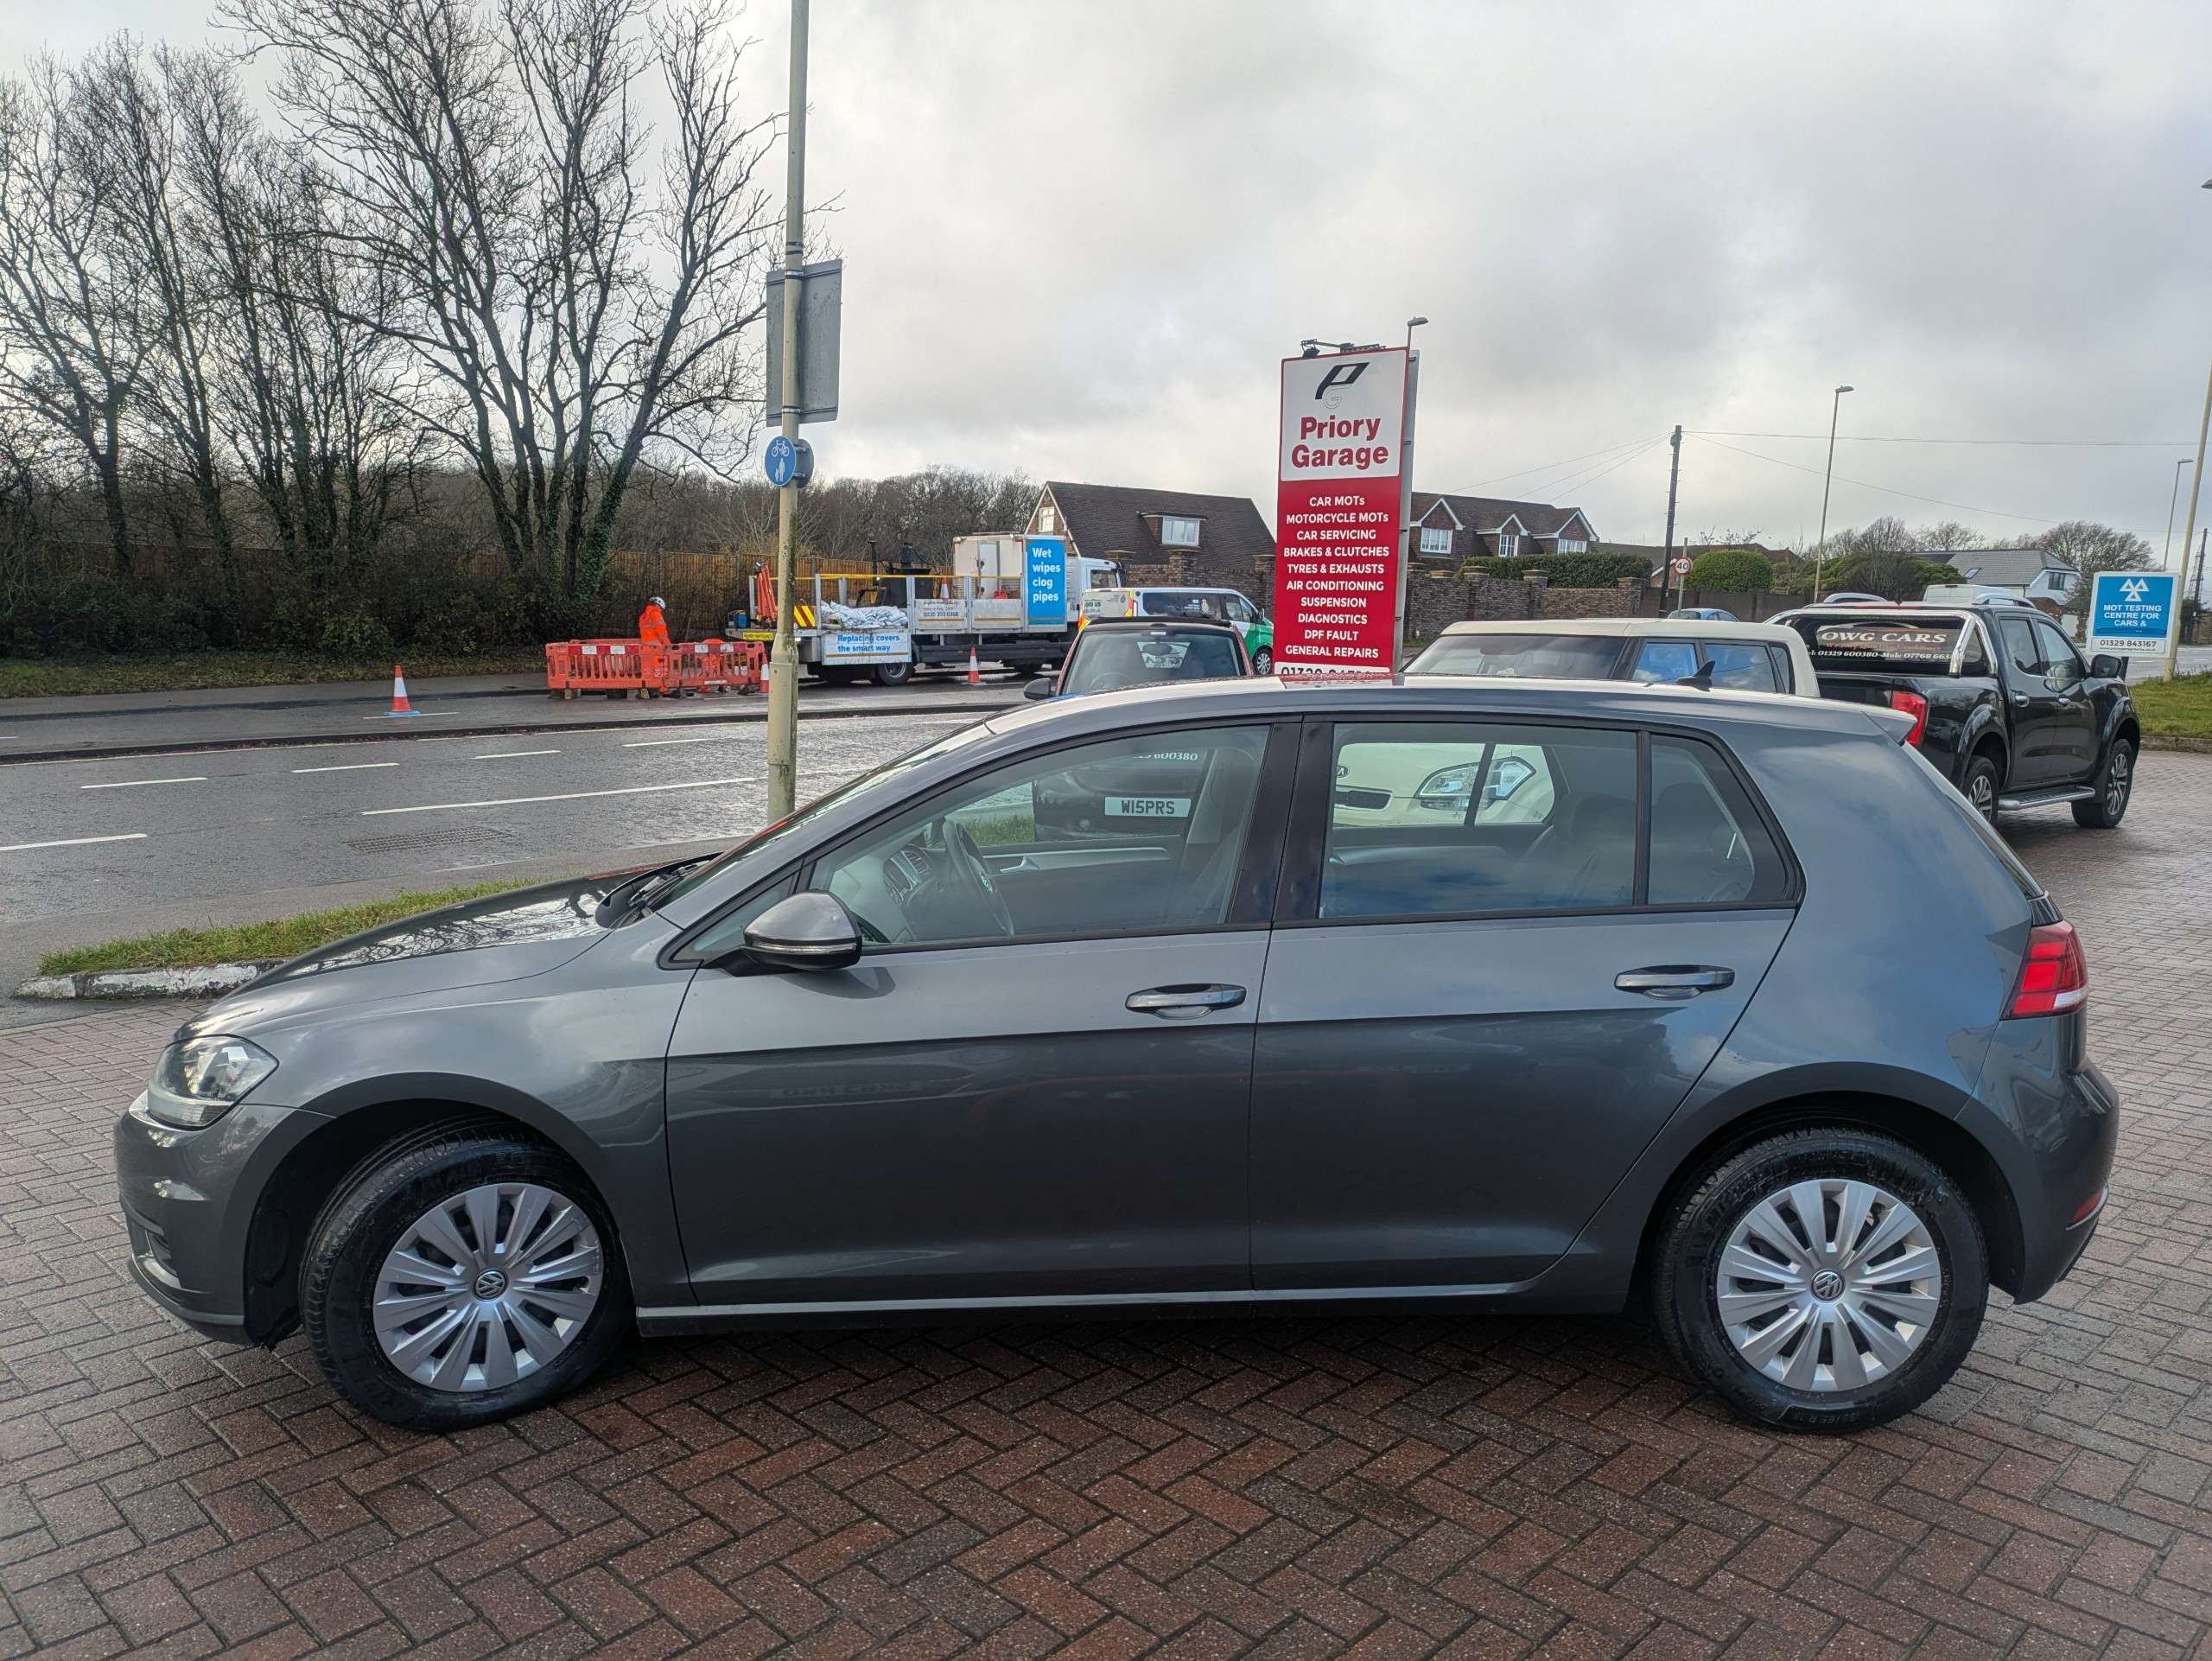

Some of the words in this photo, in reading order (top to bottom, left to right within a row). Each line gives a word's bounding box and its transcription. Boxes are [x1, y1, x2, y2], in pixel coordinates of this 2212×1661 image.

[1300, 415, 1381, 441] Priory
[1291, 444, 1389, 470] Garage
[1309, 497, 1332, 506] CAR
[1334, 495, 1365, 506] MOTs
[1286, 513, 1356, 524] MOTORCYCLE
[1358, 512, 1389, 523] MOTs
[1297, 531, 1317, 540] CAR
[1319, 530, 1376, 540] SERVICING
[1032, 546, 1052, 558] Wet
[1283, 547, 1323, 557] BRAKES
[1325, 548, 1332, 557] &
[1334, 546, 1389, 557] CLUTCHES
[1032, 562, 1061, 575] wipes
[1287, 563, 1318, 574] TYRES
[1319, 564, 1327, 574] &
[1329, 563, 1384, 574] EXHAUSTS
[1033, 576, 1053, 589] clog
[1286, 581, 1303, 590] AIR
[1306, 580, 1384, 591] CONDITIONING
[1033, 590, 1059, 604] pipes
[1300, 597, 1366, 608] SUSPENSION
[1298, 613, 1368, 624] DIAGNOSTICS
[837, 634, 874, 643] Replacing
[1305, 630, 1324, 640] DPF
[1326, 630, 1359, 640] FAULT
[1821, 632, 1876, 641] OWG
[1881, 633, 1948, 643] CARS
[1285, 646, 1332, 656] GENERAL
[1333, 646, 1379, 658] REPAIRS
